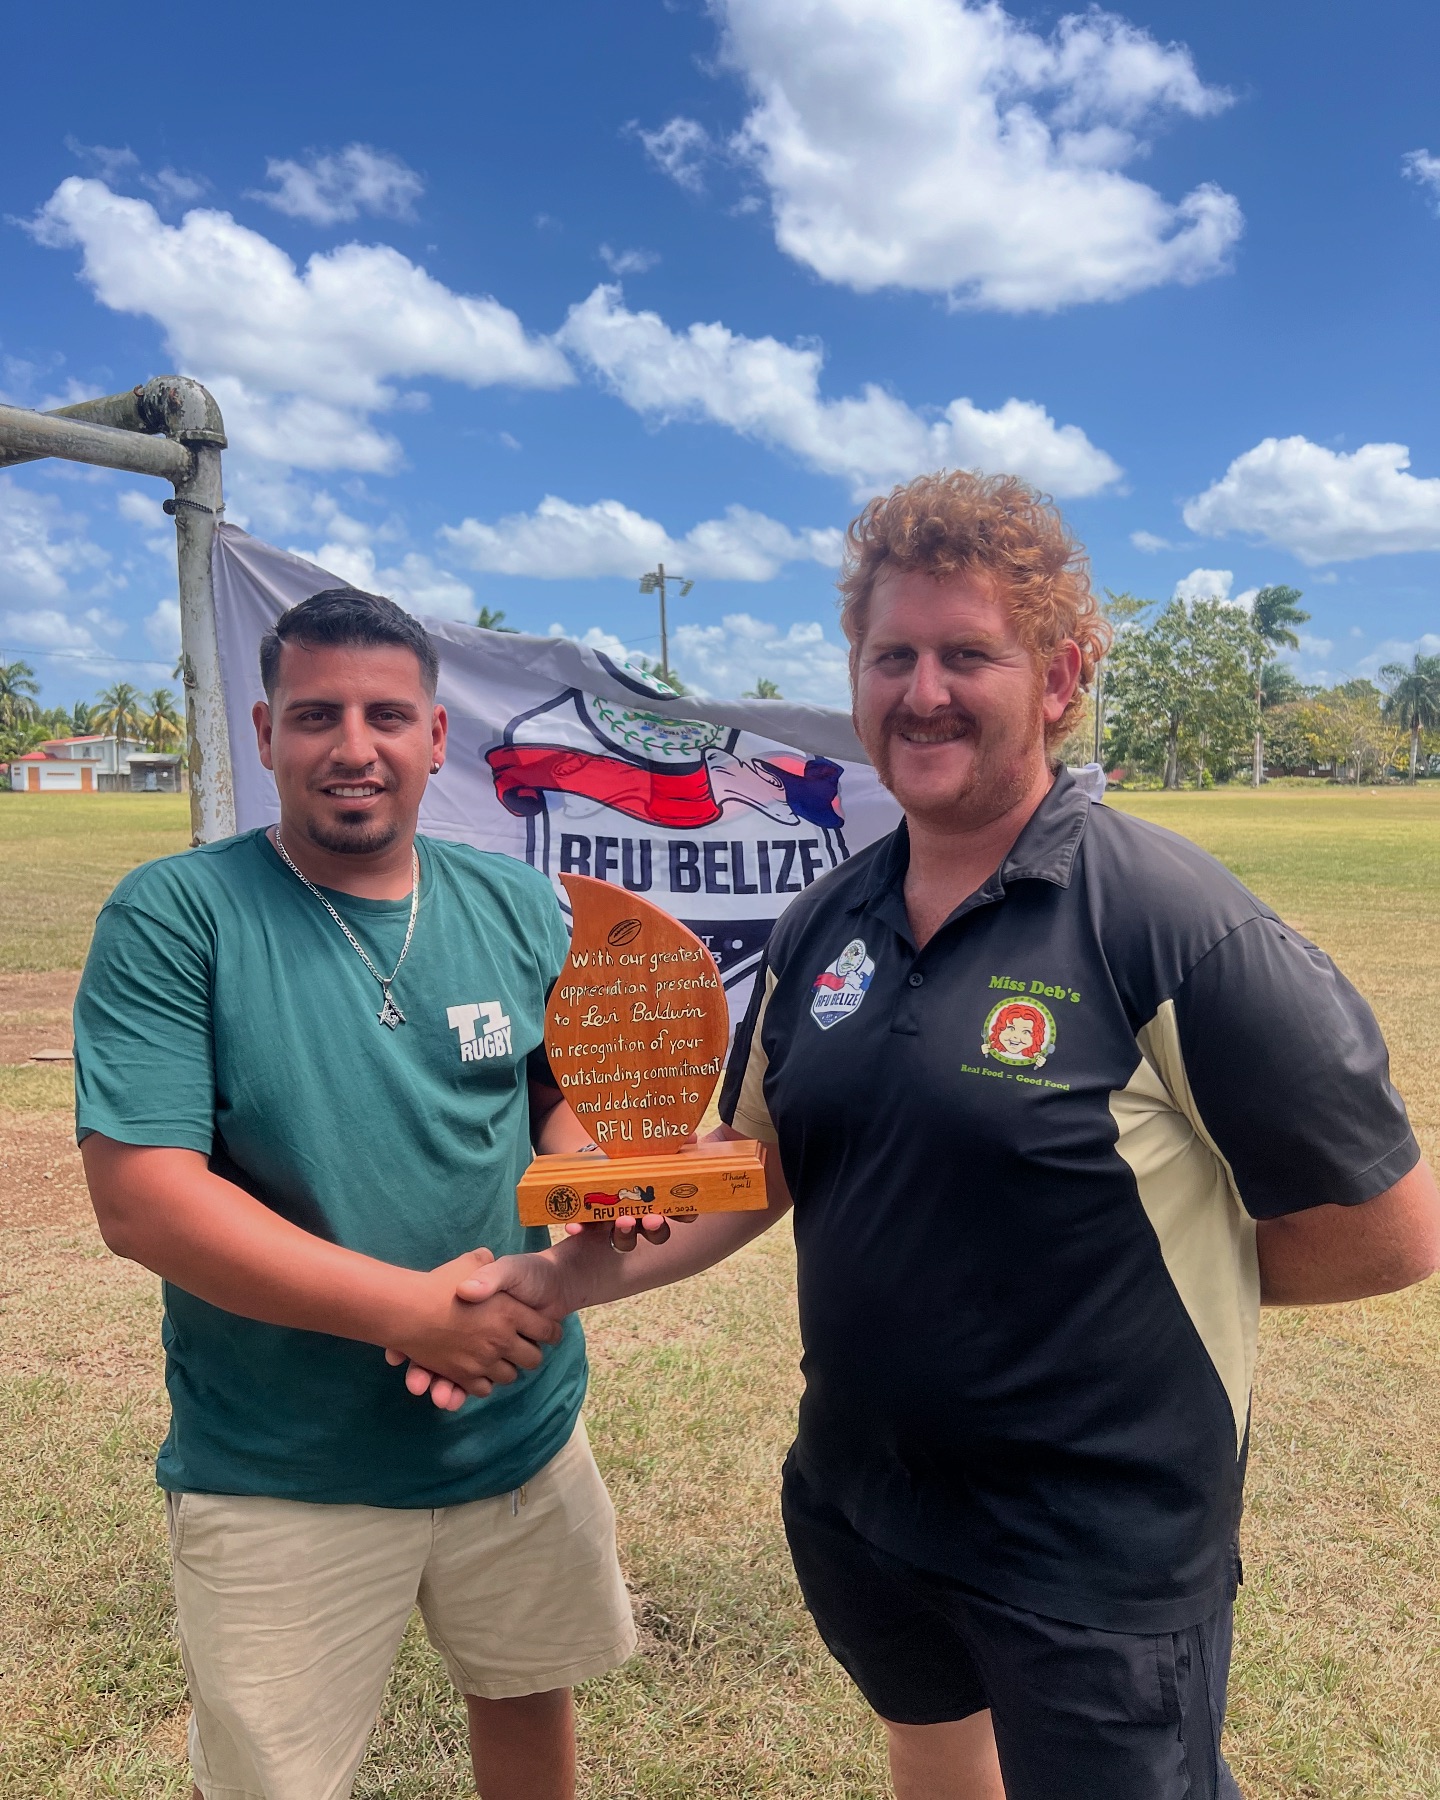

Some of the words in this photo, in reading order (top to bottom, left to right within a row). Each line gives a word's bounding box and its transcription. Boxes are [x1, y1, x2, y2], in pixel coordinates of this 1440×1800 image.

[668, 839, 824, 895] BELIZE
[571, 948, 614, 968] With
[619, 952, 647, 965] our
[650, 947, 705, 972] greatest
[560, 979, 647, 1007] appreciation
[655, 973, 717, 998] presented
[815, 995, 832, 1007] RFU
[830, 992, 861, 1006] BELIZE
[988, 975, 1026, 993] Miss
[1029, 979, 1081, 1004] Deb's
[554, 1012, 571, 1027] to
[580, 1006, 619, 1027] Levi
[631, 1002, 707, 1023] Baldwin
[460, 1026, 513, 1062] RUGBY
[551, 1042, 564, 1058] in
[568, 1035, 646, 1063] recognition
[650, 1028, 668, 1051] of
[669, 1038, 703, 1056] your
[561, 1063, 641, 1087] outstanding
[643, 1057, 720, 1078] commitment
[960, 1063, 981, 1075] Real
[981, 1067, 1004, 1080] Food
[1015, 1073, 1042, 1087] Good
[1044, 1078, 1070, 1092] Food
[576, 1092, 602, 1113] and
[604, 1090, 676, 1110] dedication
[680, 1087, 700, 1104] to
[596, 1119, 633, 1143] RFU
[642, 1118, 690, 1139] Belize
[721, 1171, 750, 1182] Thank
[593, 1207, 615, 1220] RFU
[618, 1204, 654, 1216] BELIZE
